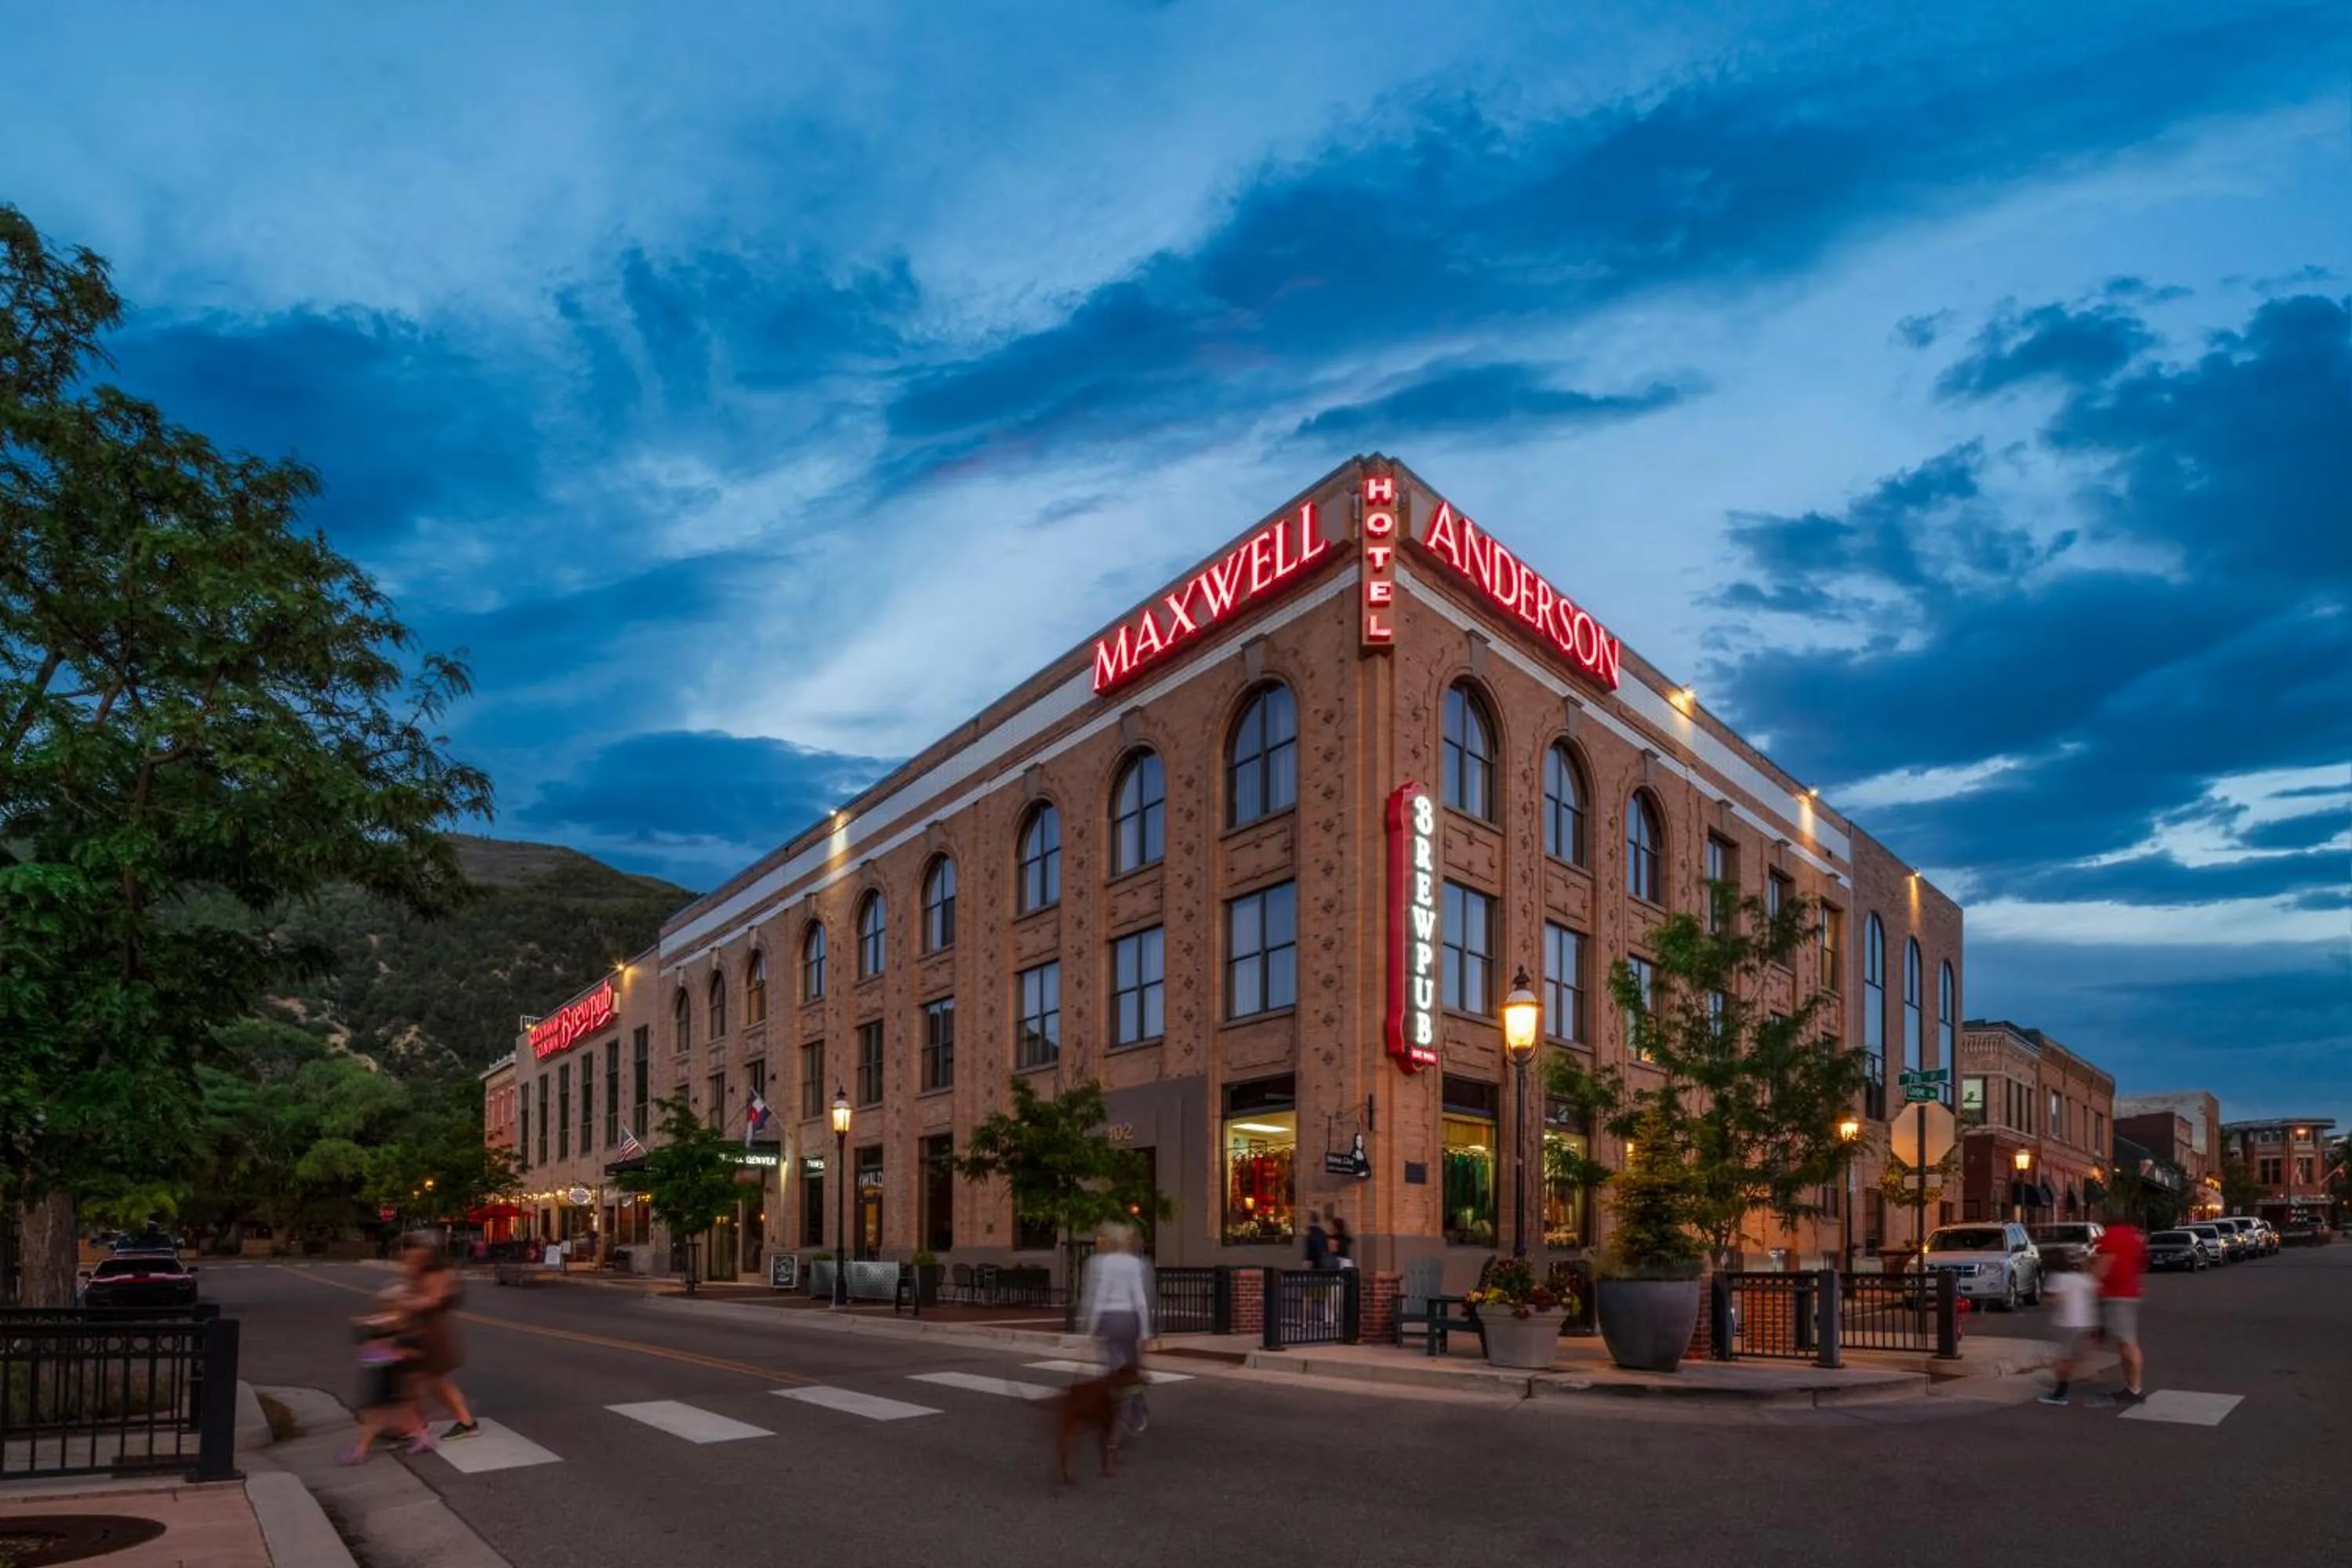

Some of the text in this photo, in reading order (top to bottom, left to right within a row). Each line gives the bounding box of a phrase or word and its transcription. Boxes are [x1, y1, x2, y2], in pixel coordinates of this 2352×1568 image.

[1092, 501, 1329, 694] MAXWELL
[1367, 477, 1393, 641] HOTEL
[1425, 501, 1620, 691] ANDERSON
[560, 979, 612, 1049] Brewpub
[1411, 794, 1436, 1045] BREWPUB
